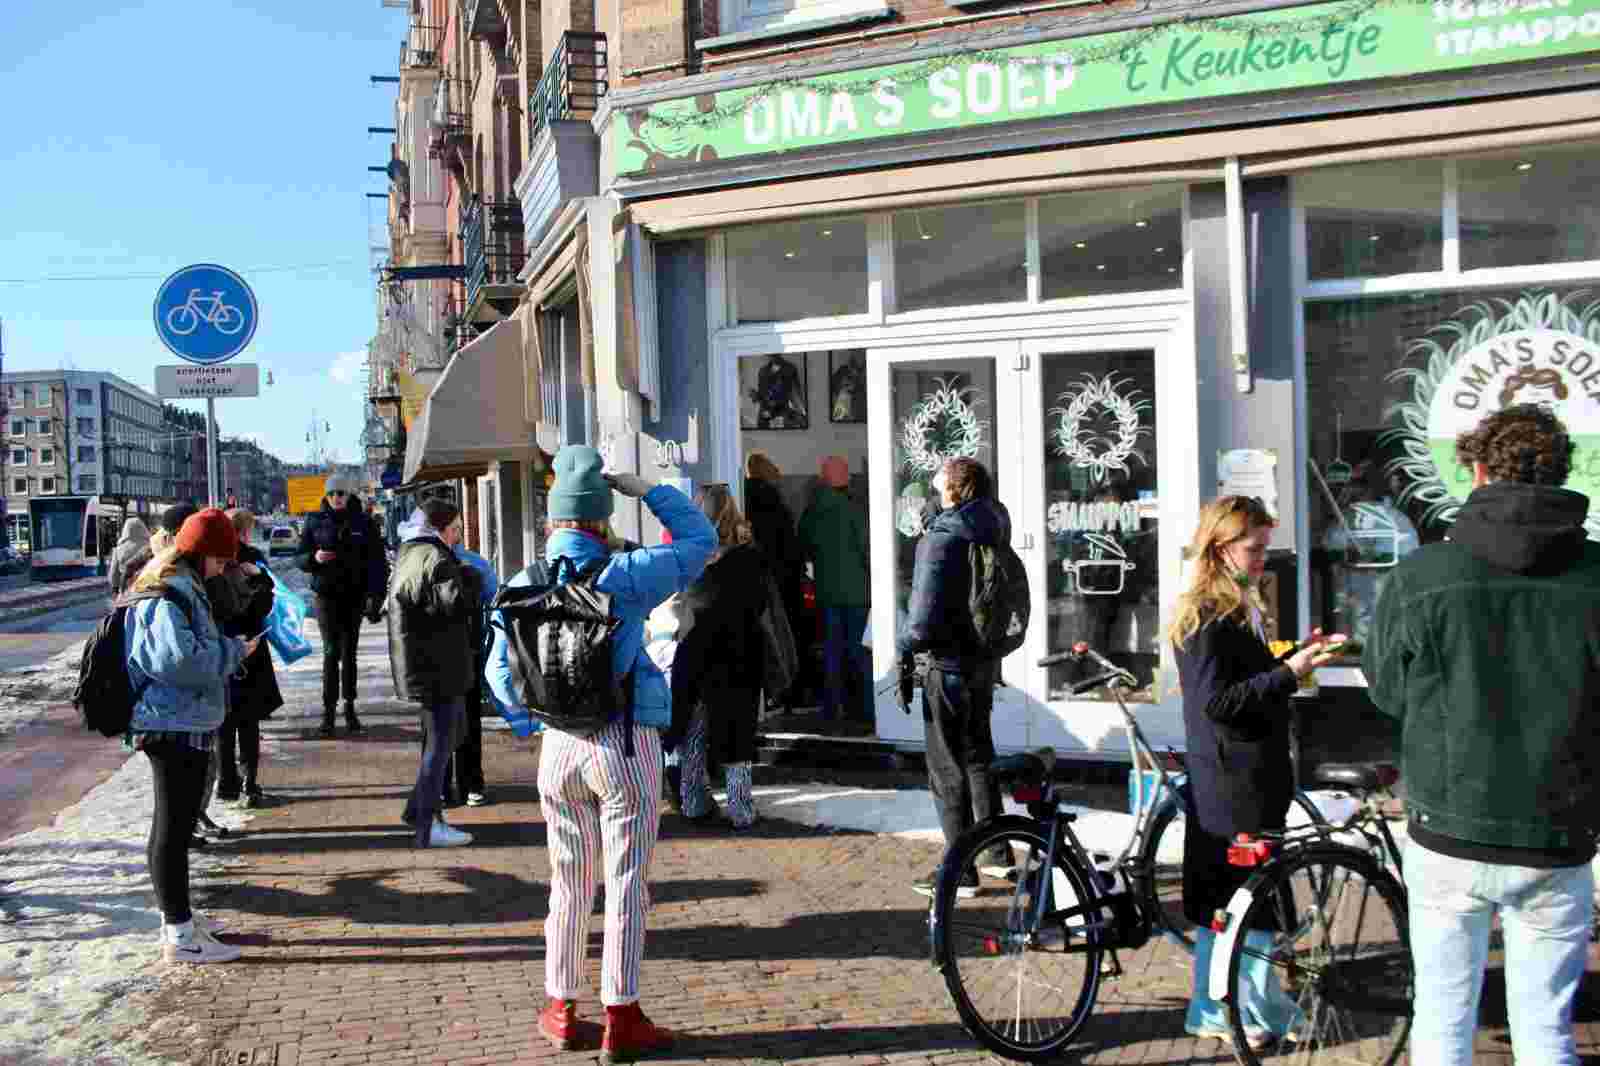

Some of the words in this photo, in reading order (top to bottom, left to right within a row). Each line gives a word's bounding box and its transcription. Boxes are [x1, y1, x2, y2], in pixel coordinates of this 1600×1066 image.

[1160, 21, 1381, 91] Keukentje
[742, 77, 905, 145] OMAS
[928, 53, 1075, 120] SOEP
[1453, 338, 1535, 410] OMA'S
